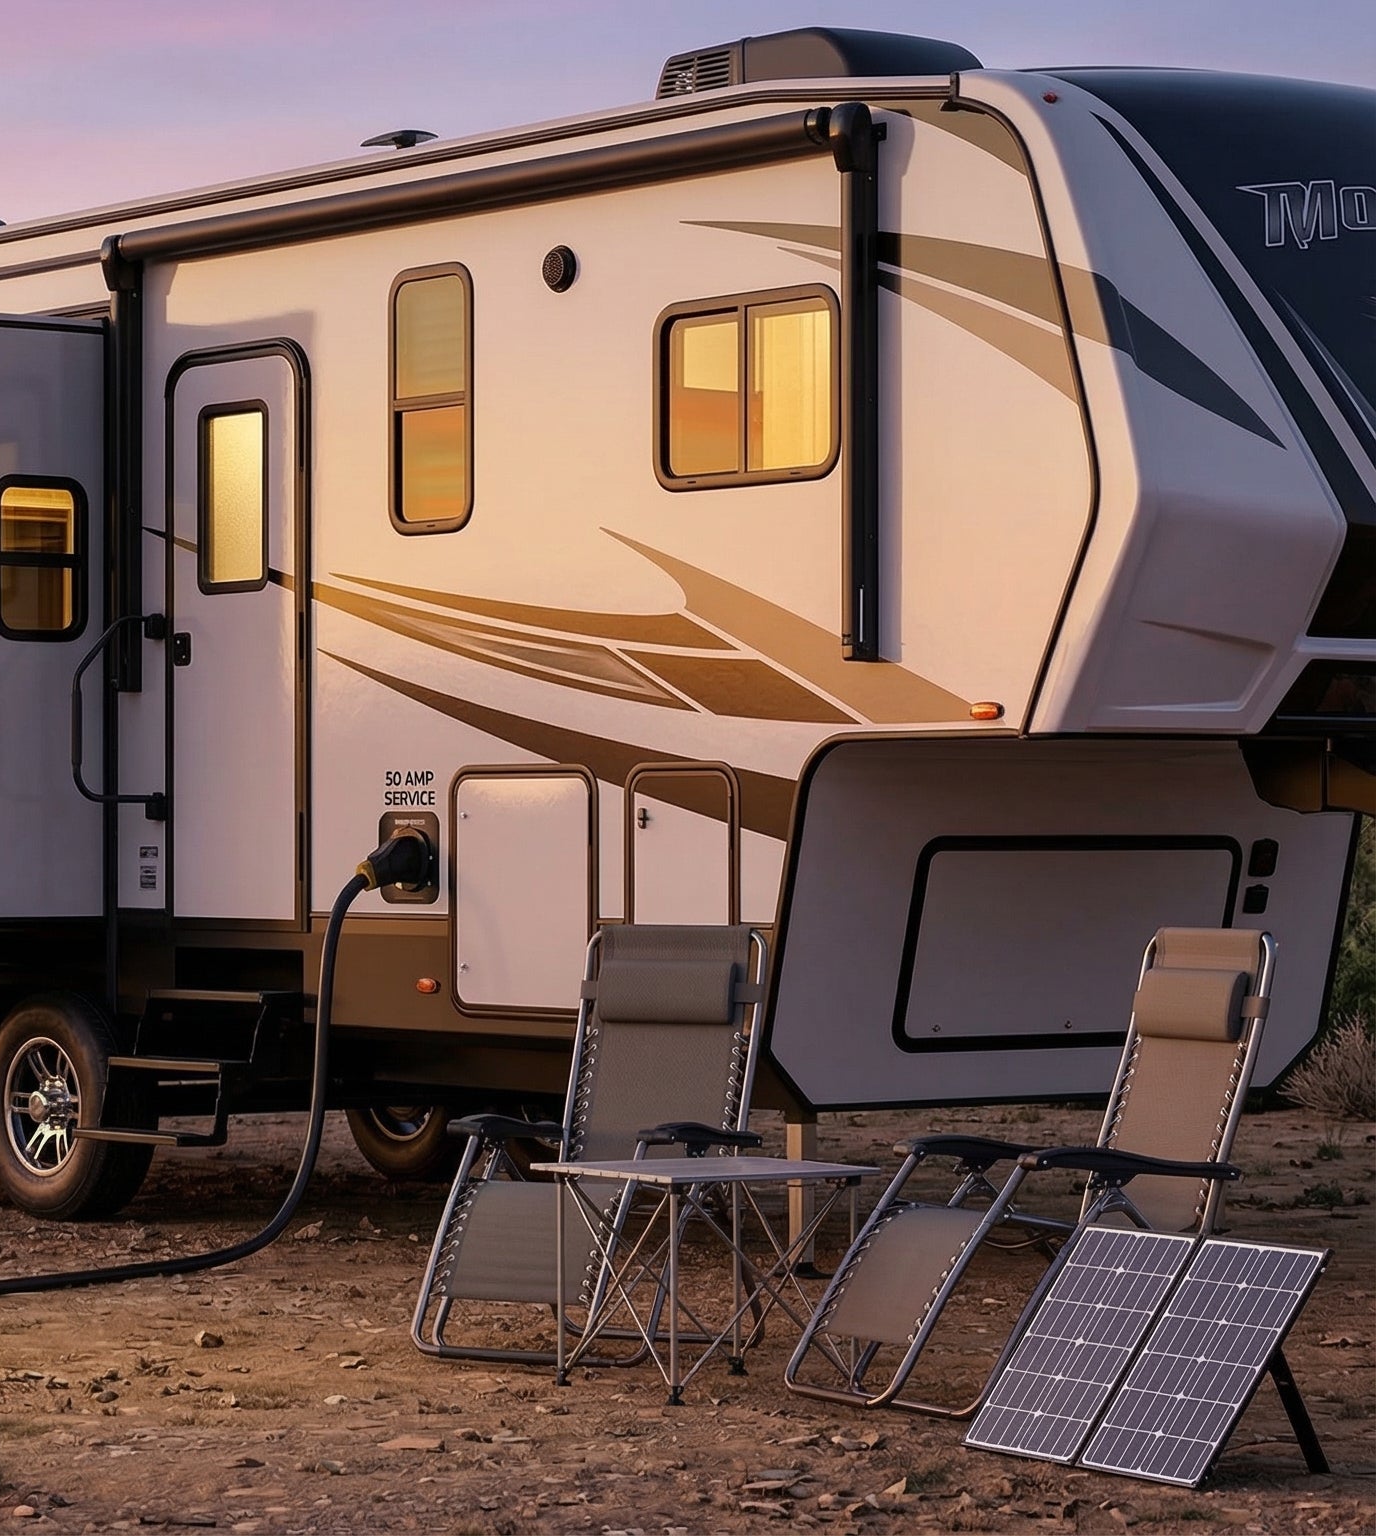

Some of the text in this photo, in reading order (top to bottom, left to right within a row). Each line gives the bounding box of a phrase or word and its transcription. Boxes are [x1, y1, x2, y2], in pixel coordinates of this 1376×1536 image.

[385, 770, 434, 786] 50 AMP
[384, 790, 436, 806] SERVICE
